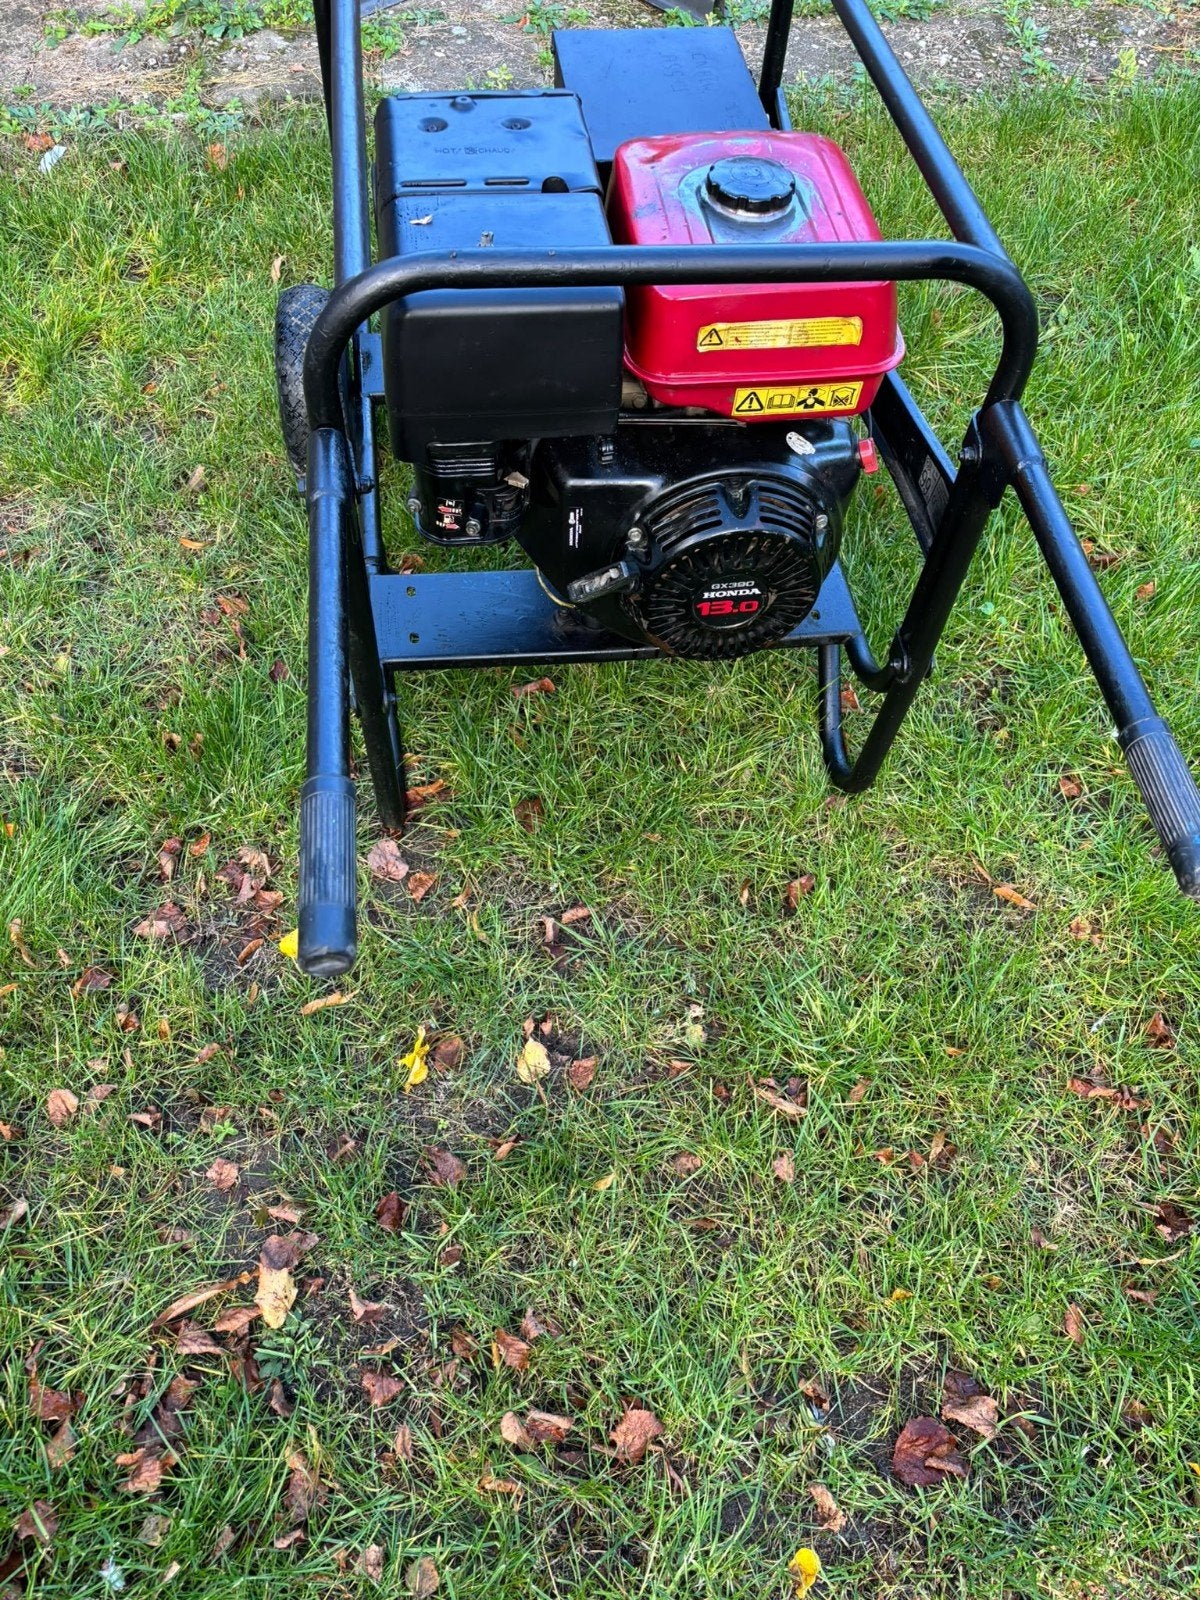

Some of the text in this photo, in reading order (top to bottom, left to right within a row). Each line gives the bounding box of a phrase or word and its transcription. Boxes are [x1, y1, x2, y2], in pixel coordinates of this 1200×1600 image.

[711, 580, 755, 590] GX390
[702, 588, 762, 599] HONDA
[696, 600, 759, 616] 13.0
